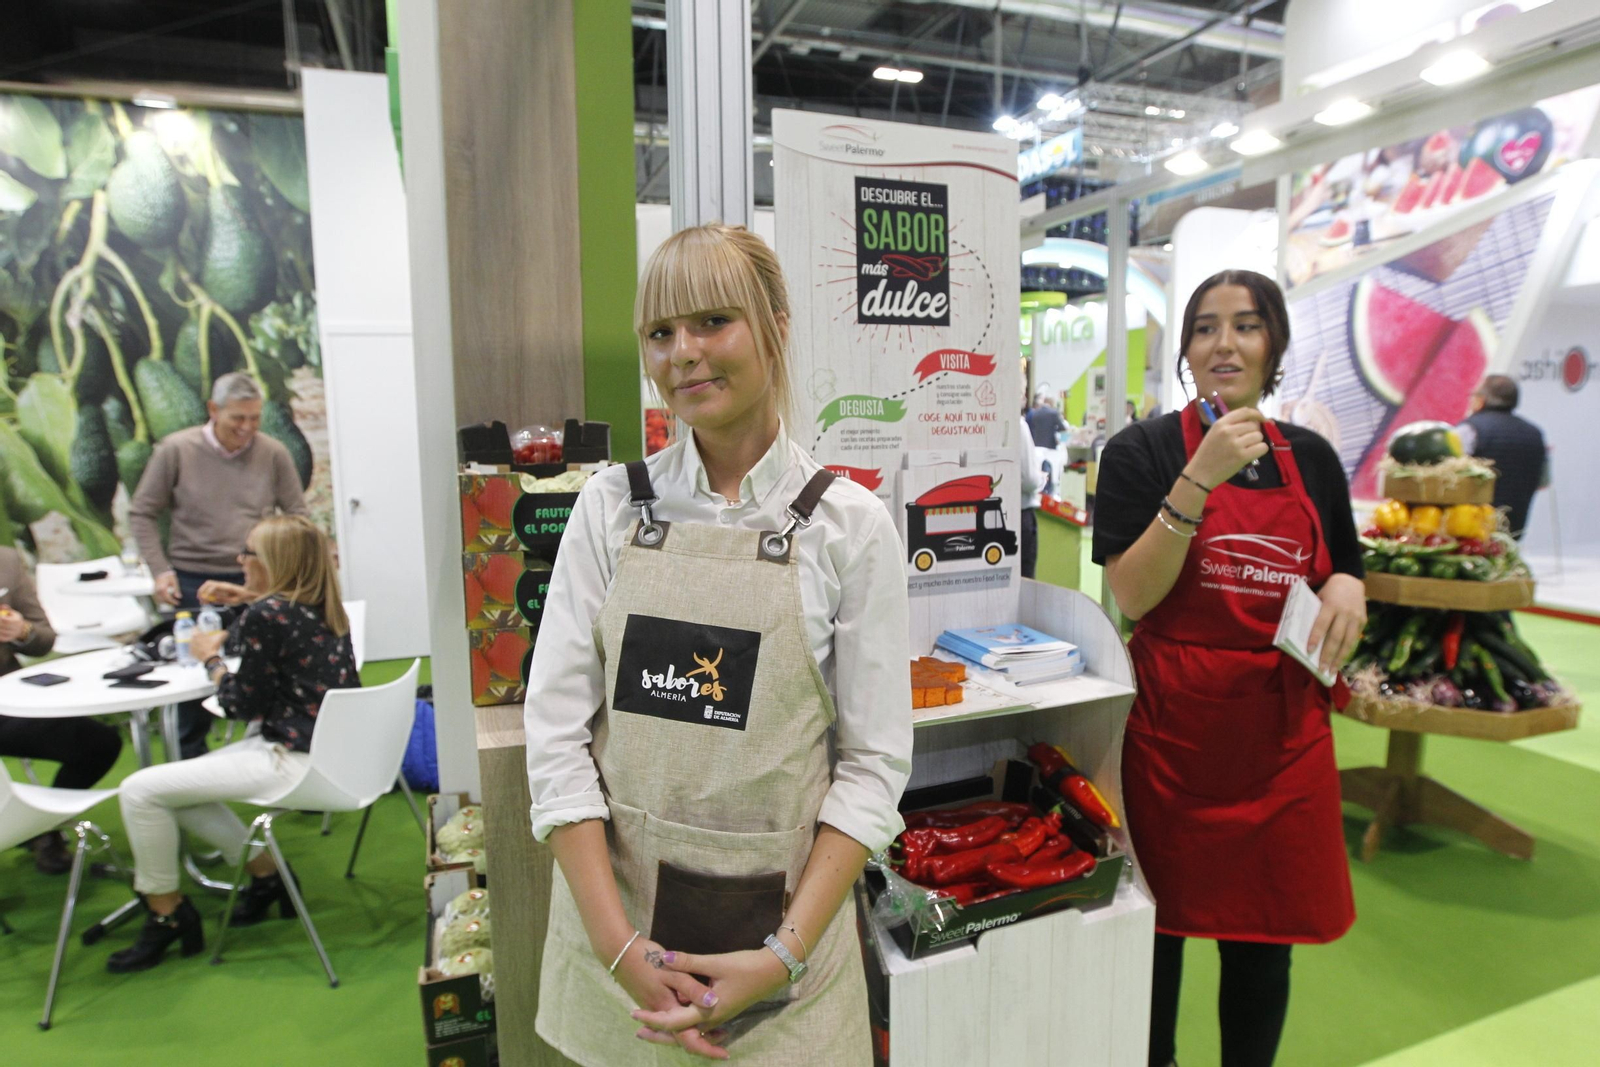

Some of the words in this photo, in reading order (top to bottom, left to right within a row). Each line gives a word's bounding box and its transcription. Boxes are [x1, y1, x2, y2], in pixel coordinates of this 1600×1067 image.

[860, 186, 918, 206] DESCUBRE
[920, 191, 944, 209] EL...
[862, 207, 945, 254] SABOR
[861, 260, 889, 277] más
[861, 278, 949, 319] dulce
[940, 353, 970, 370] VISITA
[839, 400, 885, 416] DEGUSTA
[918, 413, 941, 422] COGE
[944, 410, 963, 424] AQUÍ
[966, 412, 977, 421] TU
[980, 412, 997, 422] VALE
[524, 524, 538, 534] EL
[942, 577, 954, 586] más
[527, 599, 540, 609] EL
[641, 664, 727, 701] sabores
[650, 689, 687, 702] ALMERÍA
[929, 912, 1019, 944] SweetPalermo
